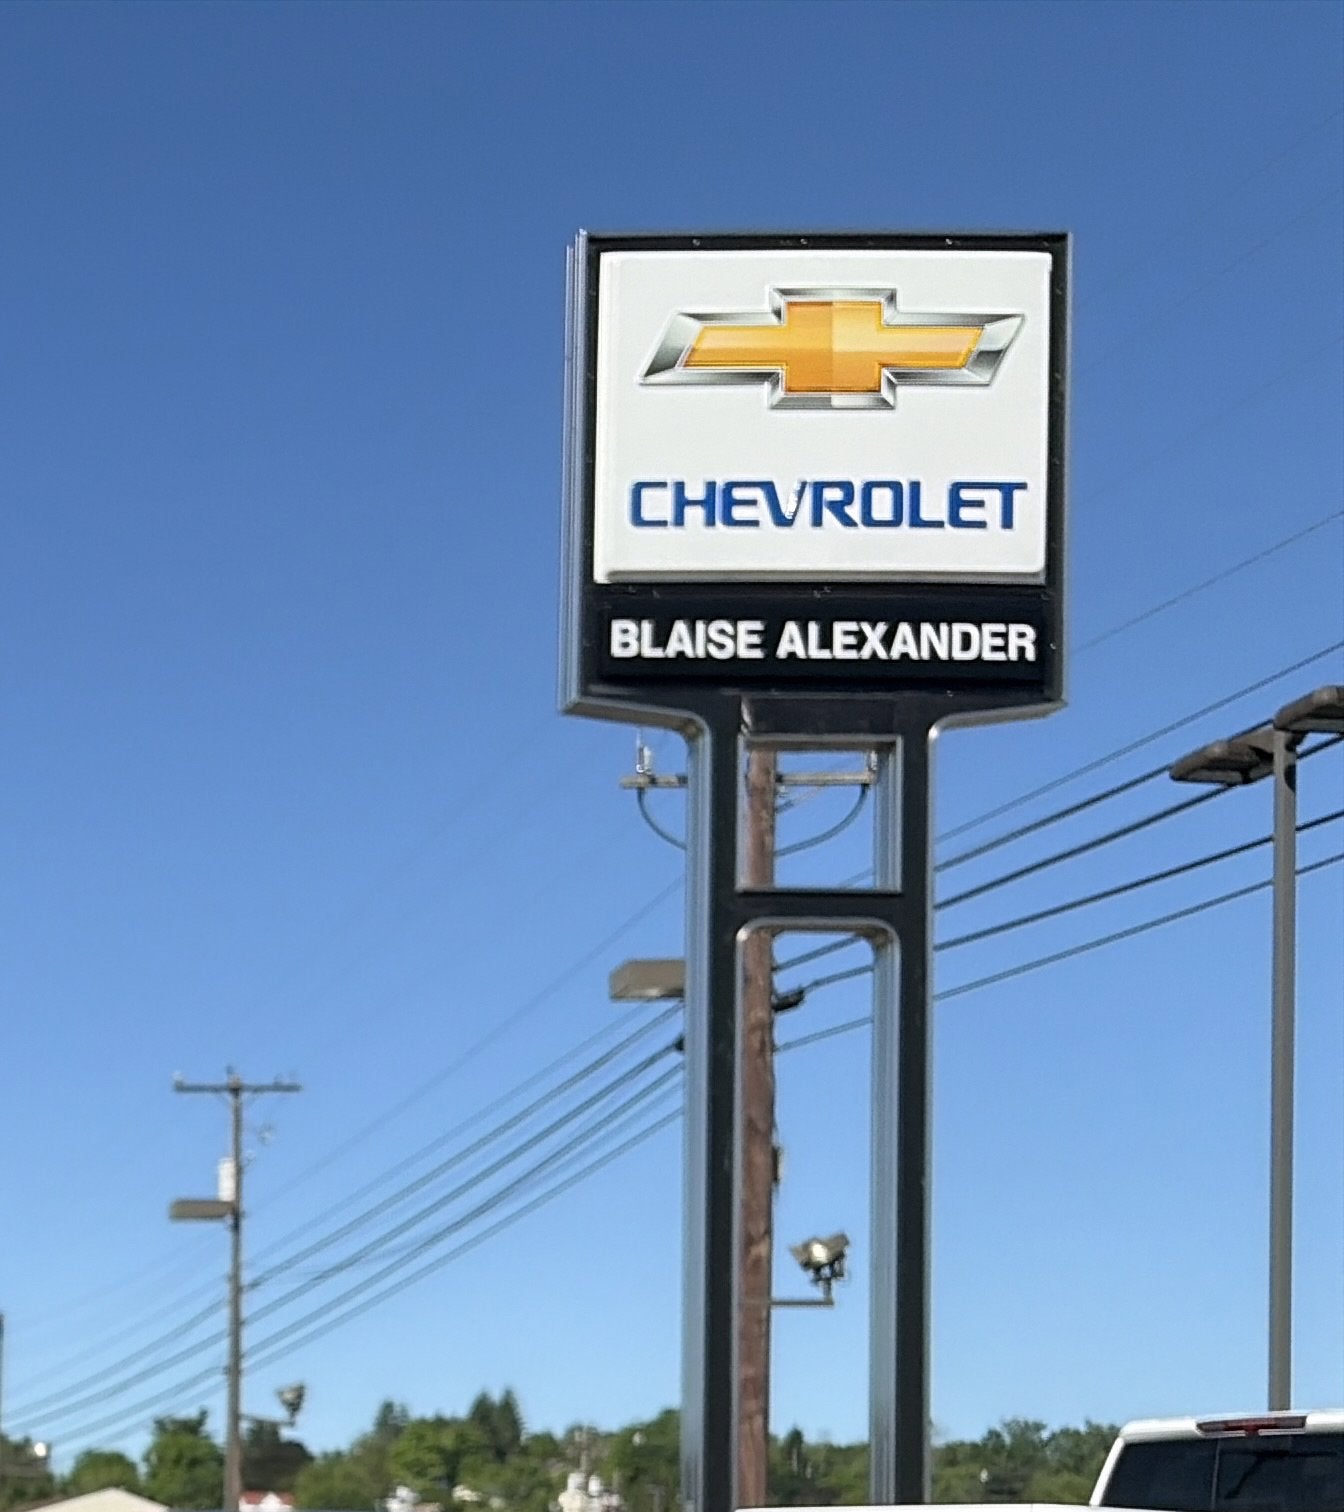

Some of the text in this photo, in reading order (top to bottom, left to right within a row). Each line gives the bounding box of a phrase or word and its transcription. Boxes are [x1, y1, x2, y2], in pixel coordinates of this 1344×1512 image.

[630, 480, 1028, 530] CHEVROLET
[611, 618, 1037, 662] BLAISE ALEXANDER
